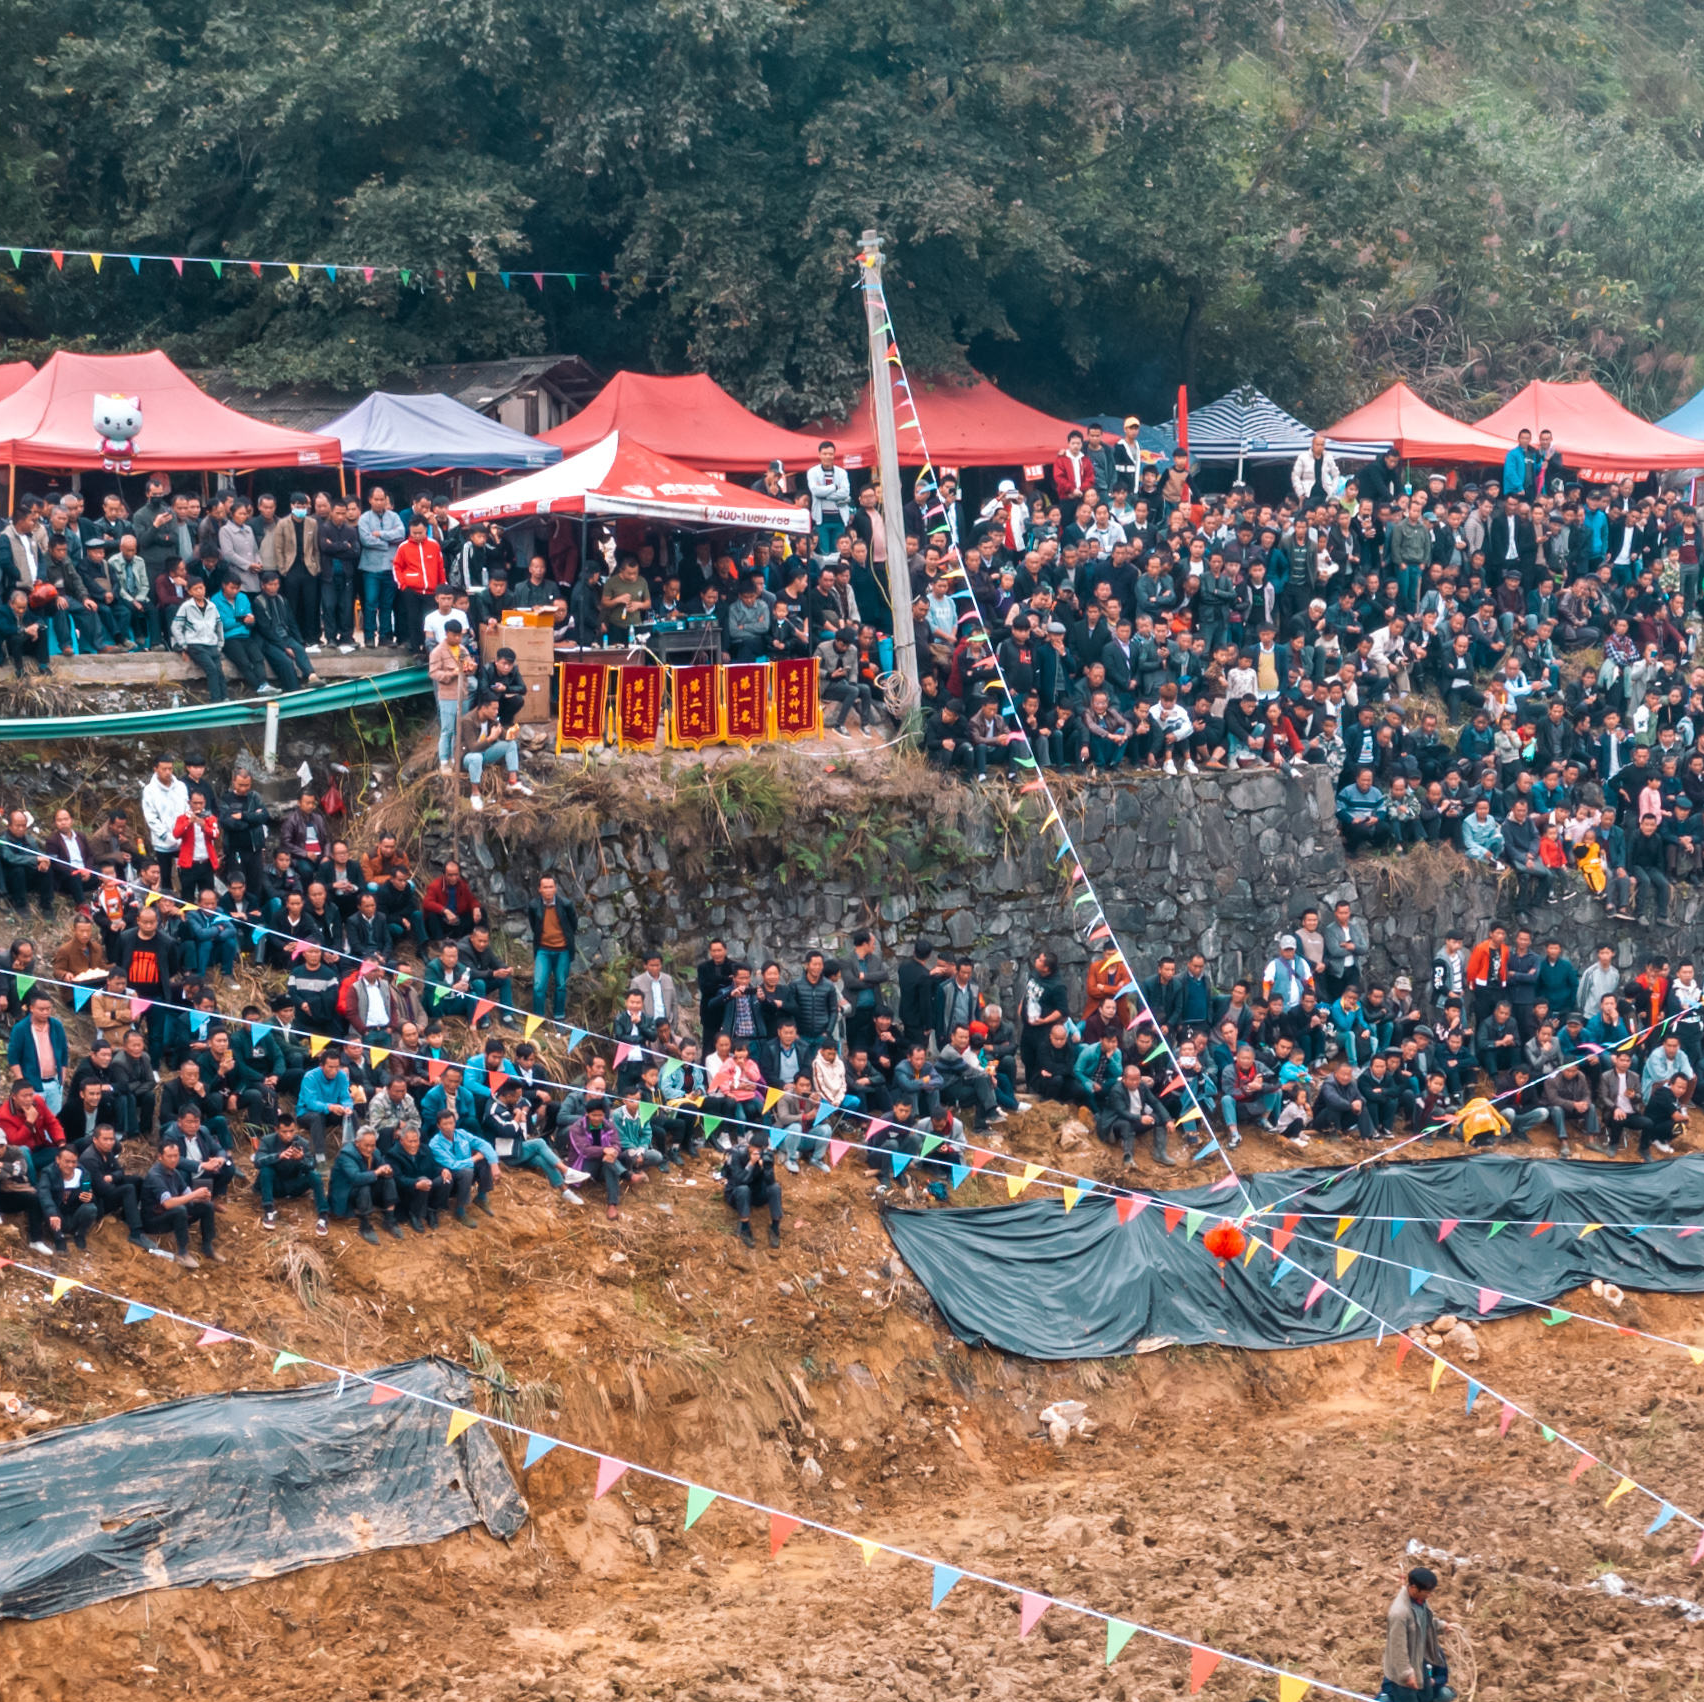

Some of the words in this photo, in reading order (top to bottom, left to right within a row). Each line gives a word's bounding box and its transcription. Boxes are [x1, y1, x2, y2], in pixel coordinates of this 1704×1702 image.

[631, 678, 645, 727] 第三名
[689, 677, 702, 727] 第二名
[738, 675, 752, 724] 第一名
